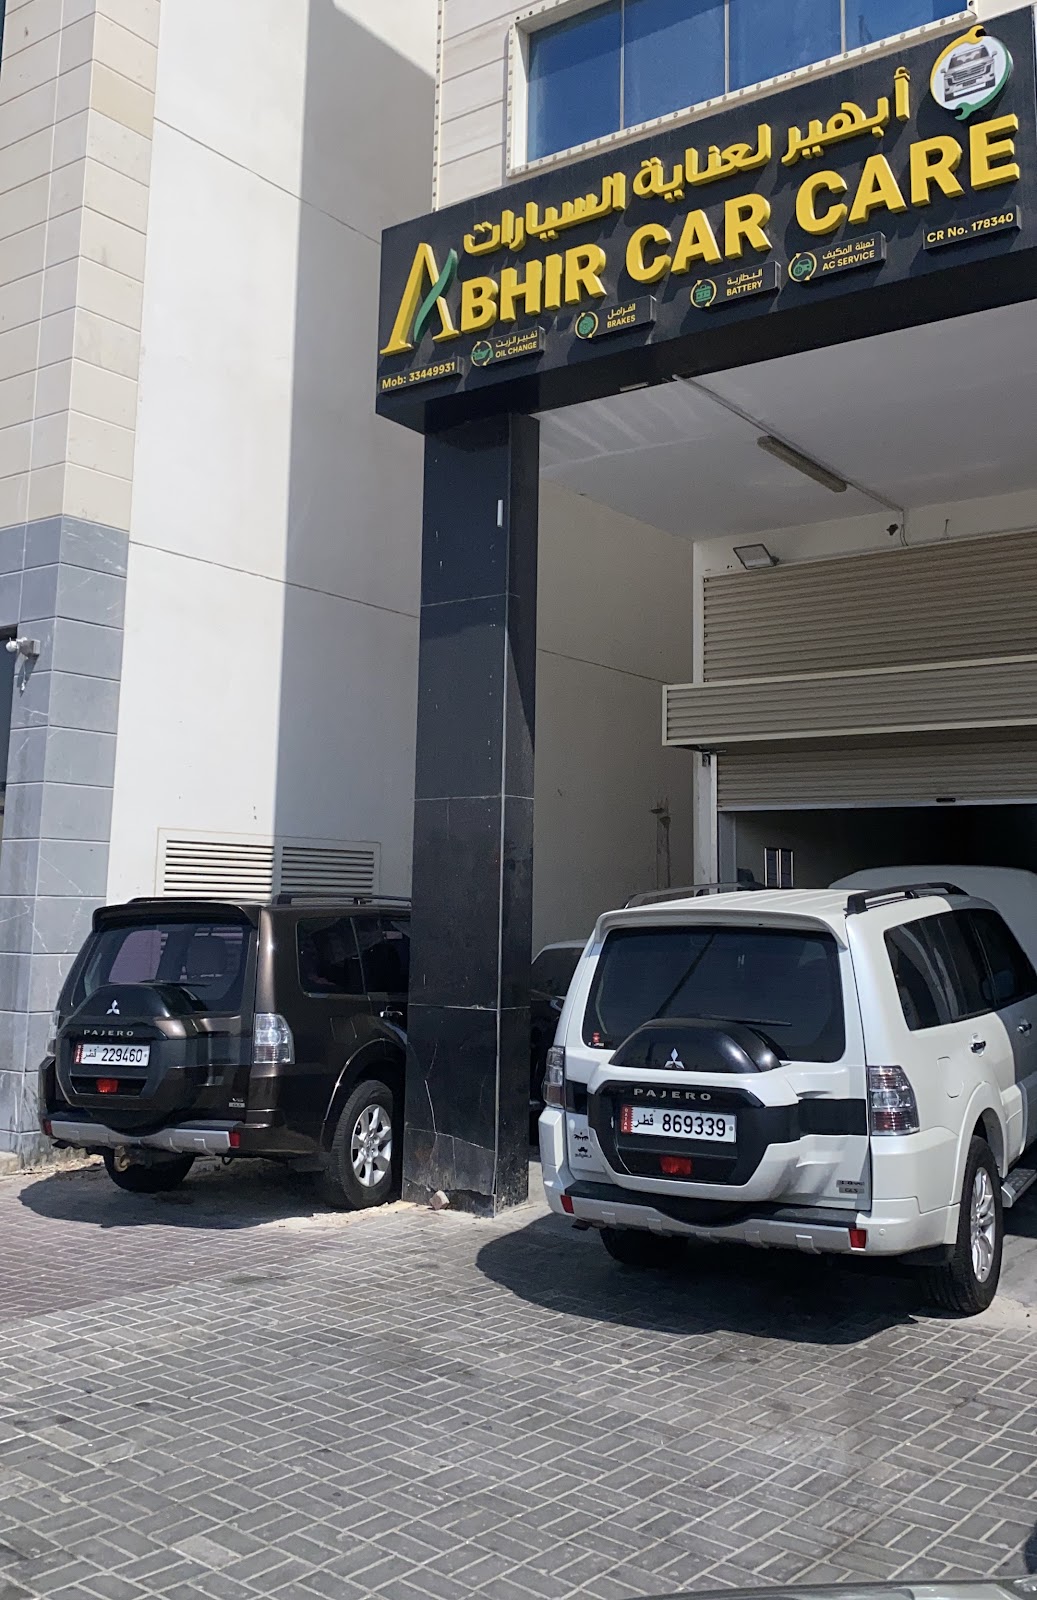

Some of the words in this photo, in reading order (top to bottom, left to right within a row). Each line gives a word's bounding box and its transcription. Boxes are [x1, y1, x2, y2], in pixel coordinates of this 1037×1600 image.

[781, 66, 911, 166] أبهير
[633, 123, 772, 203] لعناية
[463, 171, 626, 256] السيارات
[380, 242, 608, 355] ABHIR
[626, 193, 773, 284] CAR
[796, 113, 1021, 236] CARE
[926, 230, 945, 243] CR
[947, 226, 968, 238] No.
[971, 211, 1014, 232] 178340
[822, 244, 853, 260] المكيف
[822, 261, 836, 271] AC
[837, 250, 875, 267] SERVICE
[726, 268, 763, 286] البطارية
[726, 279, 763, 297] BATTERY
[607, 302, 636, 320] الفرامل
[606, 314, 636, 329] BRAKES
[495, 350, 507, 359] OIL
[507, 341, 537, 355] CHANGE
[381, 376, 407, 390] Mob:
[408, 361, 456, 383] 33449931
[83, 1029, 135, 1037] PAJERO
[101, 1047, 143, 1063] 229460
[633, 1088, 712, 1101] PAJERO
[633, 1113, 654, 1128] قطر
[662, 1113, 726, 1138] 869339
